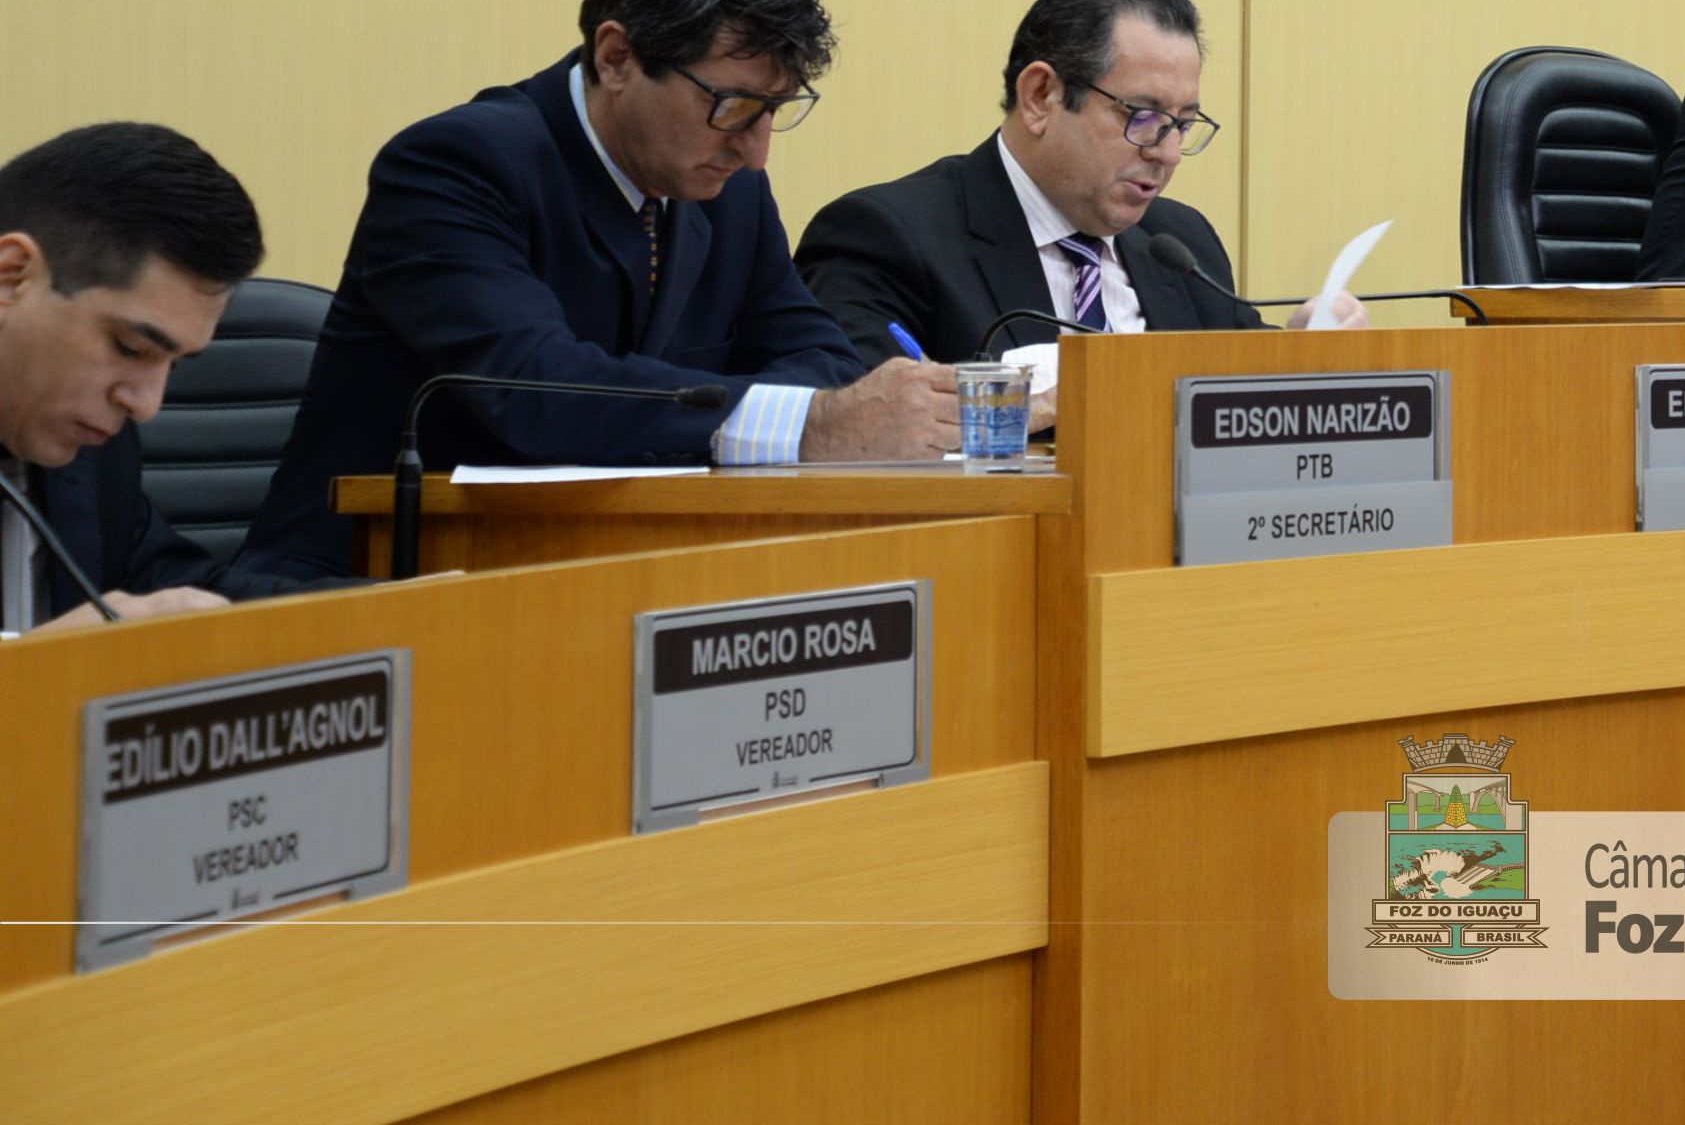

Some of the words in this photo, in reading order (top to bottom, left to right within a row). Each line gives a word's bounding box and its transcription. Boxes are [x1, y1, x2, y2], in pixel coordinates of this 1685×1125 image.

[1215, 406, 1300, 439] EDSON
[1307, 395, 1411, 435] NARIZÃO
[1297, 453, 1333, 480] PTB
[1248, 516, 1265, 541] 2º
[1271, 503, 1394, 540] SECRETÁRIO
[692, 627, 798, 676] MARCIO
[804, 618, 876, 660] ROSA
[765, 688, 806, 722] PSD
[104, 723, 201, 791] EDÍLIO
[208, 696, 384, 770] DALL'AGNOL
[736, 728, 833, 767] VEREADOR
[228, 795, 266, 831] PSC
[193, 832, 299, 885] VEREADOR
